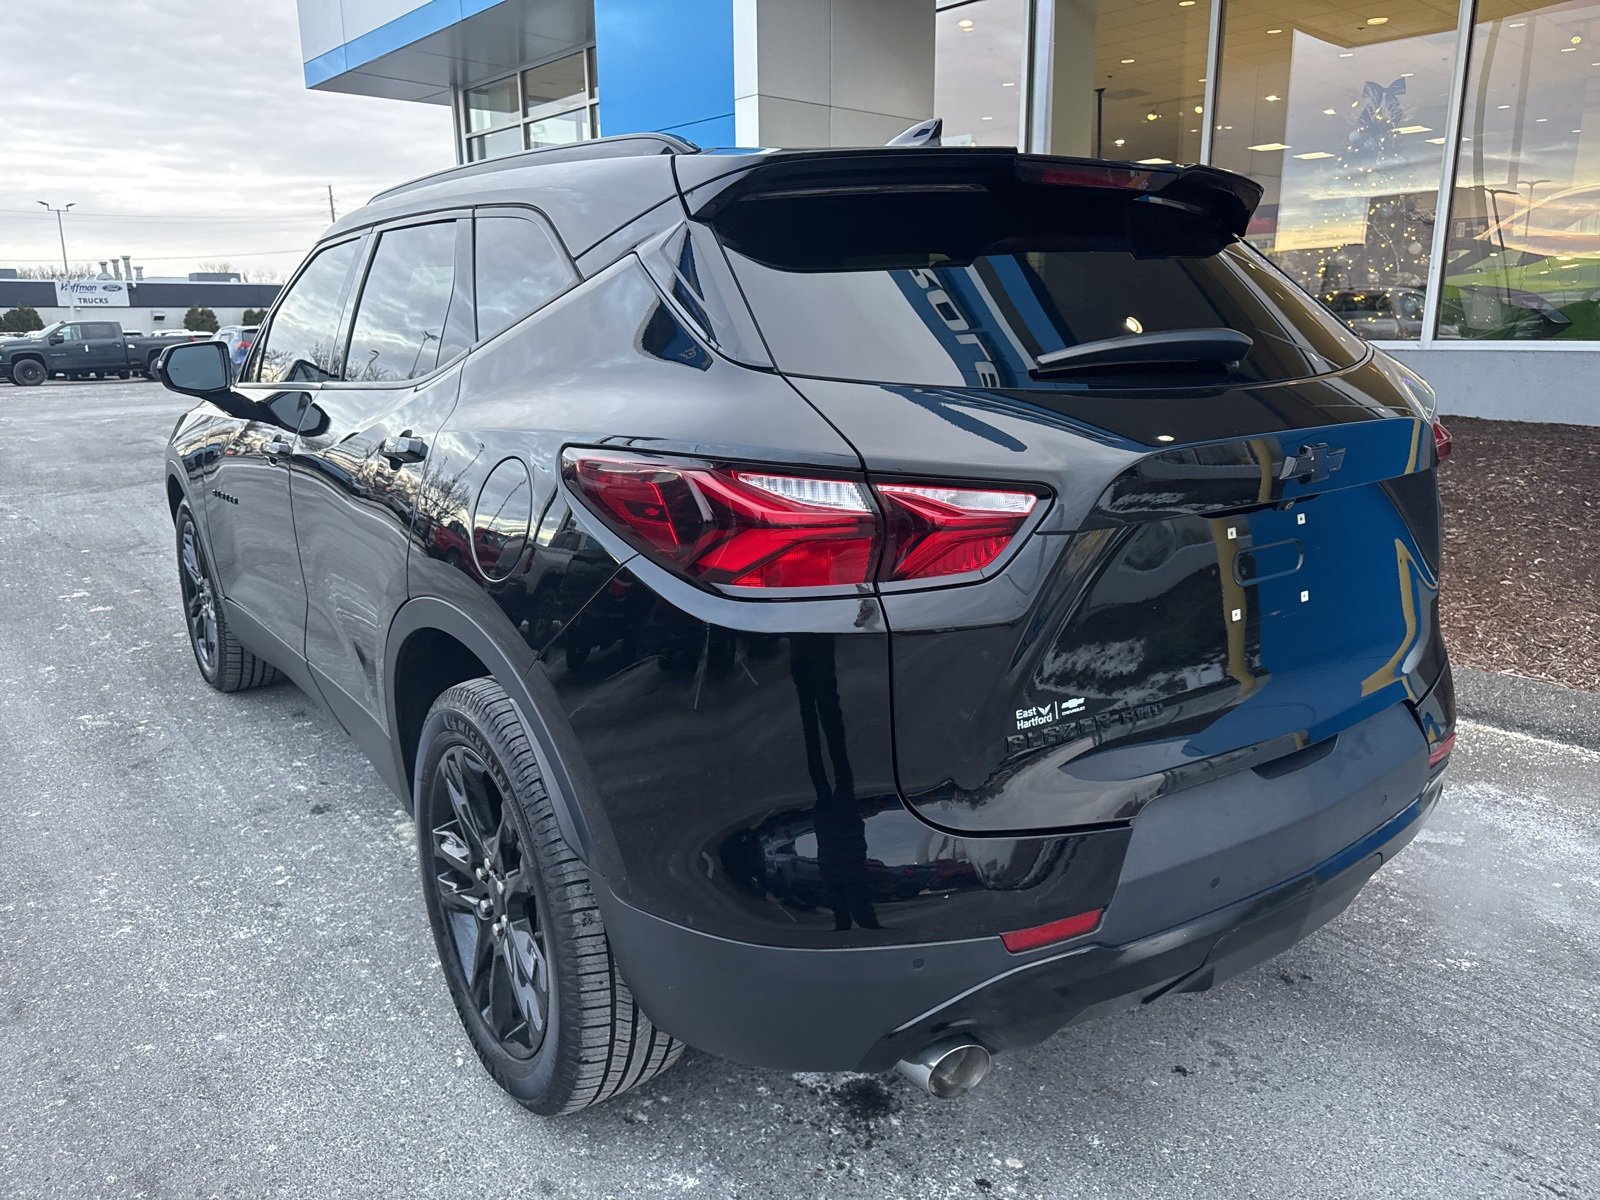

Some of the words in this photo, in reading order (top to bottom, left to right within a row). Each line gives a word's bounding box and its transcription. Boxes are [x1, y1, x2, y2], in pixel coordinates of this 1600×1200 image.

[1015, 707, 1037, 719] East
[1016, 712, 1053, 730] Hartford
[456, 719, 507, 791] MICHELIN
